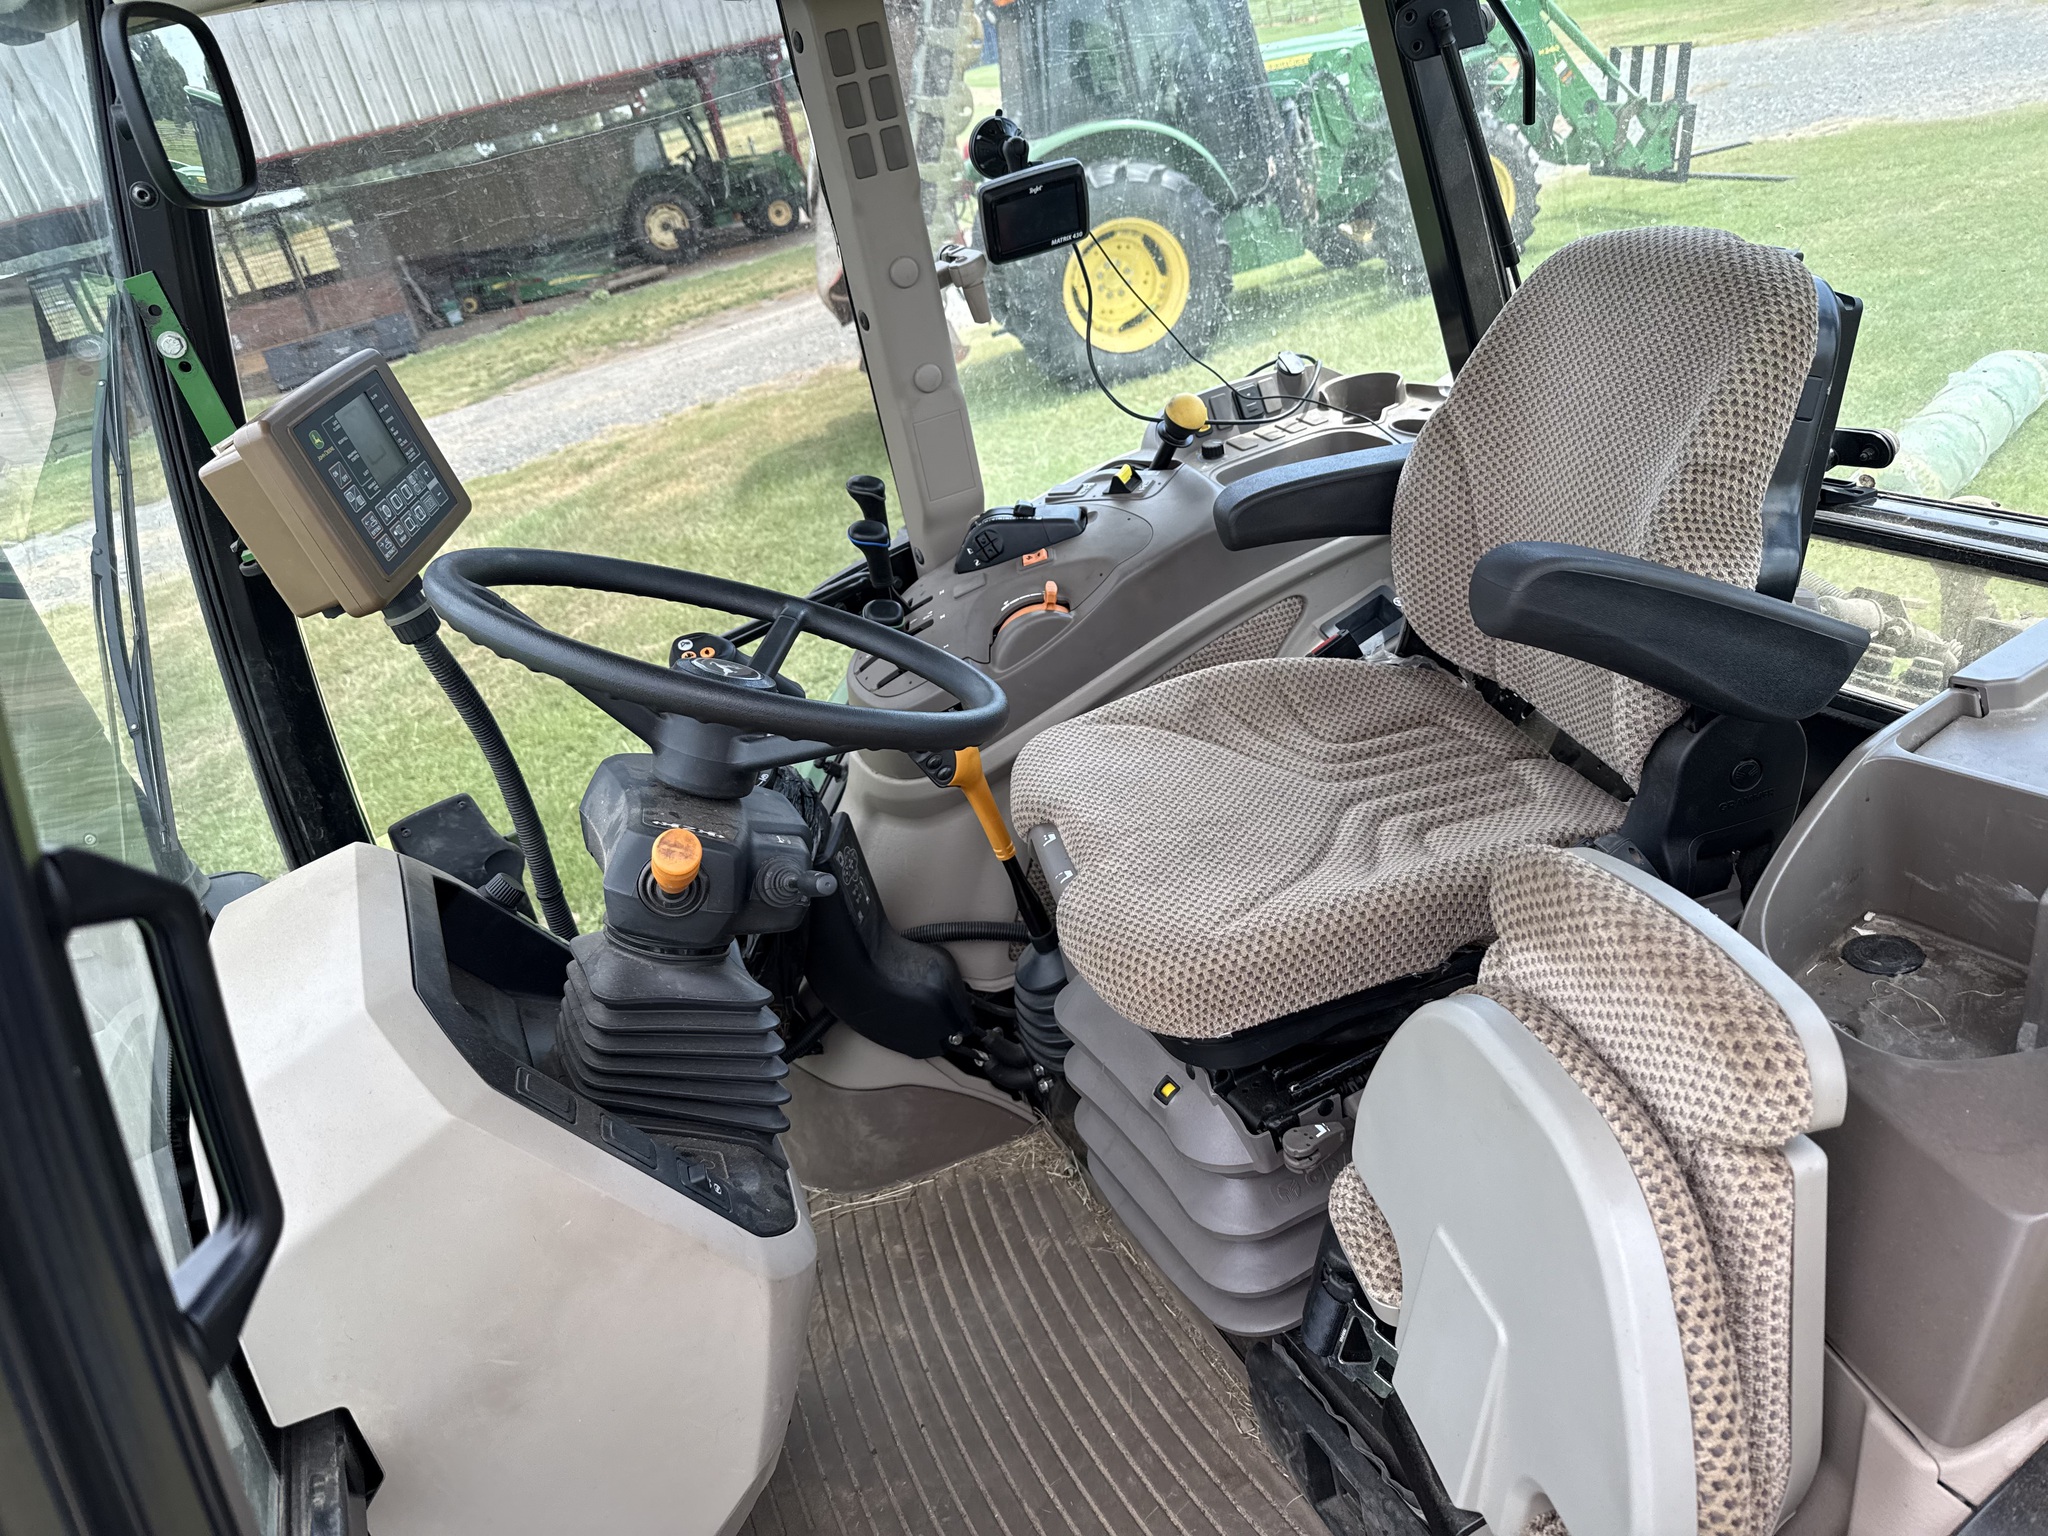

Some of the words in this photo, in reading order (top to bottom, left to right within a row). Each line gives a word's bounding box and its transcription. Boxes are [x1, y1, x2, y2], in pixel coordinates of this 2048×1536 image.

[1051, 235, 1072, 246] MATRIX
[1072, 231, 1083, 239] 430
[332, 470, 339, 478] ON
[341, 474, 349, 482] OFF
